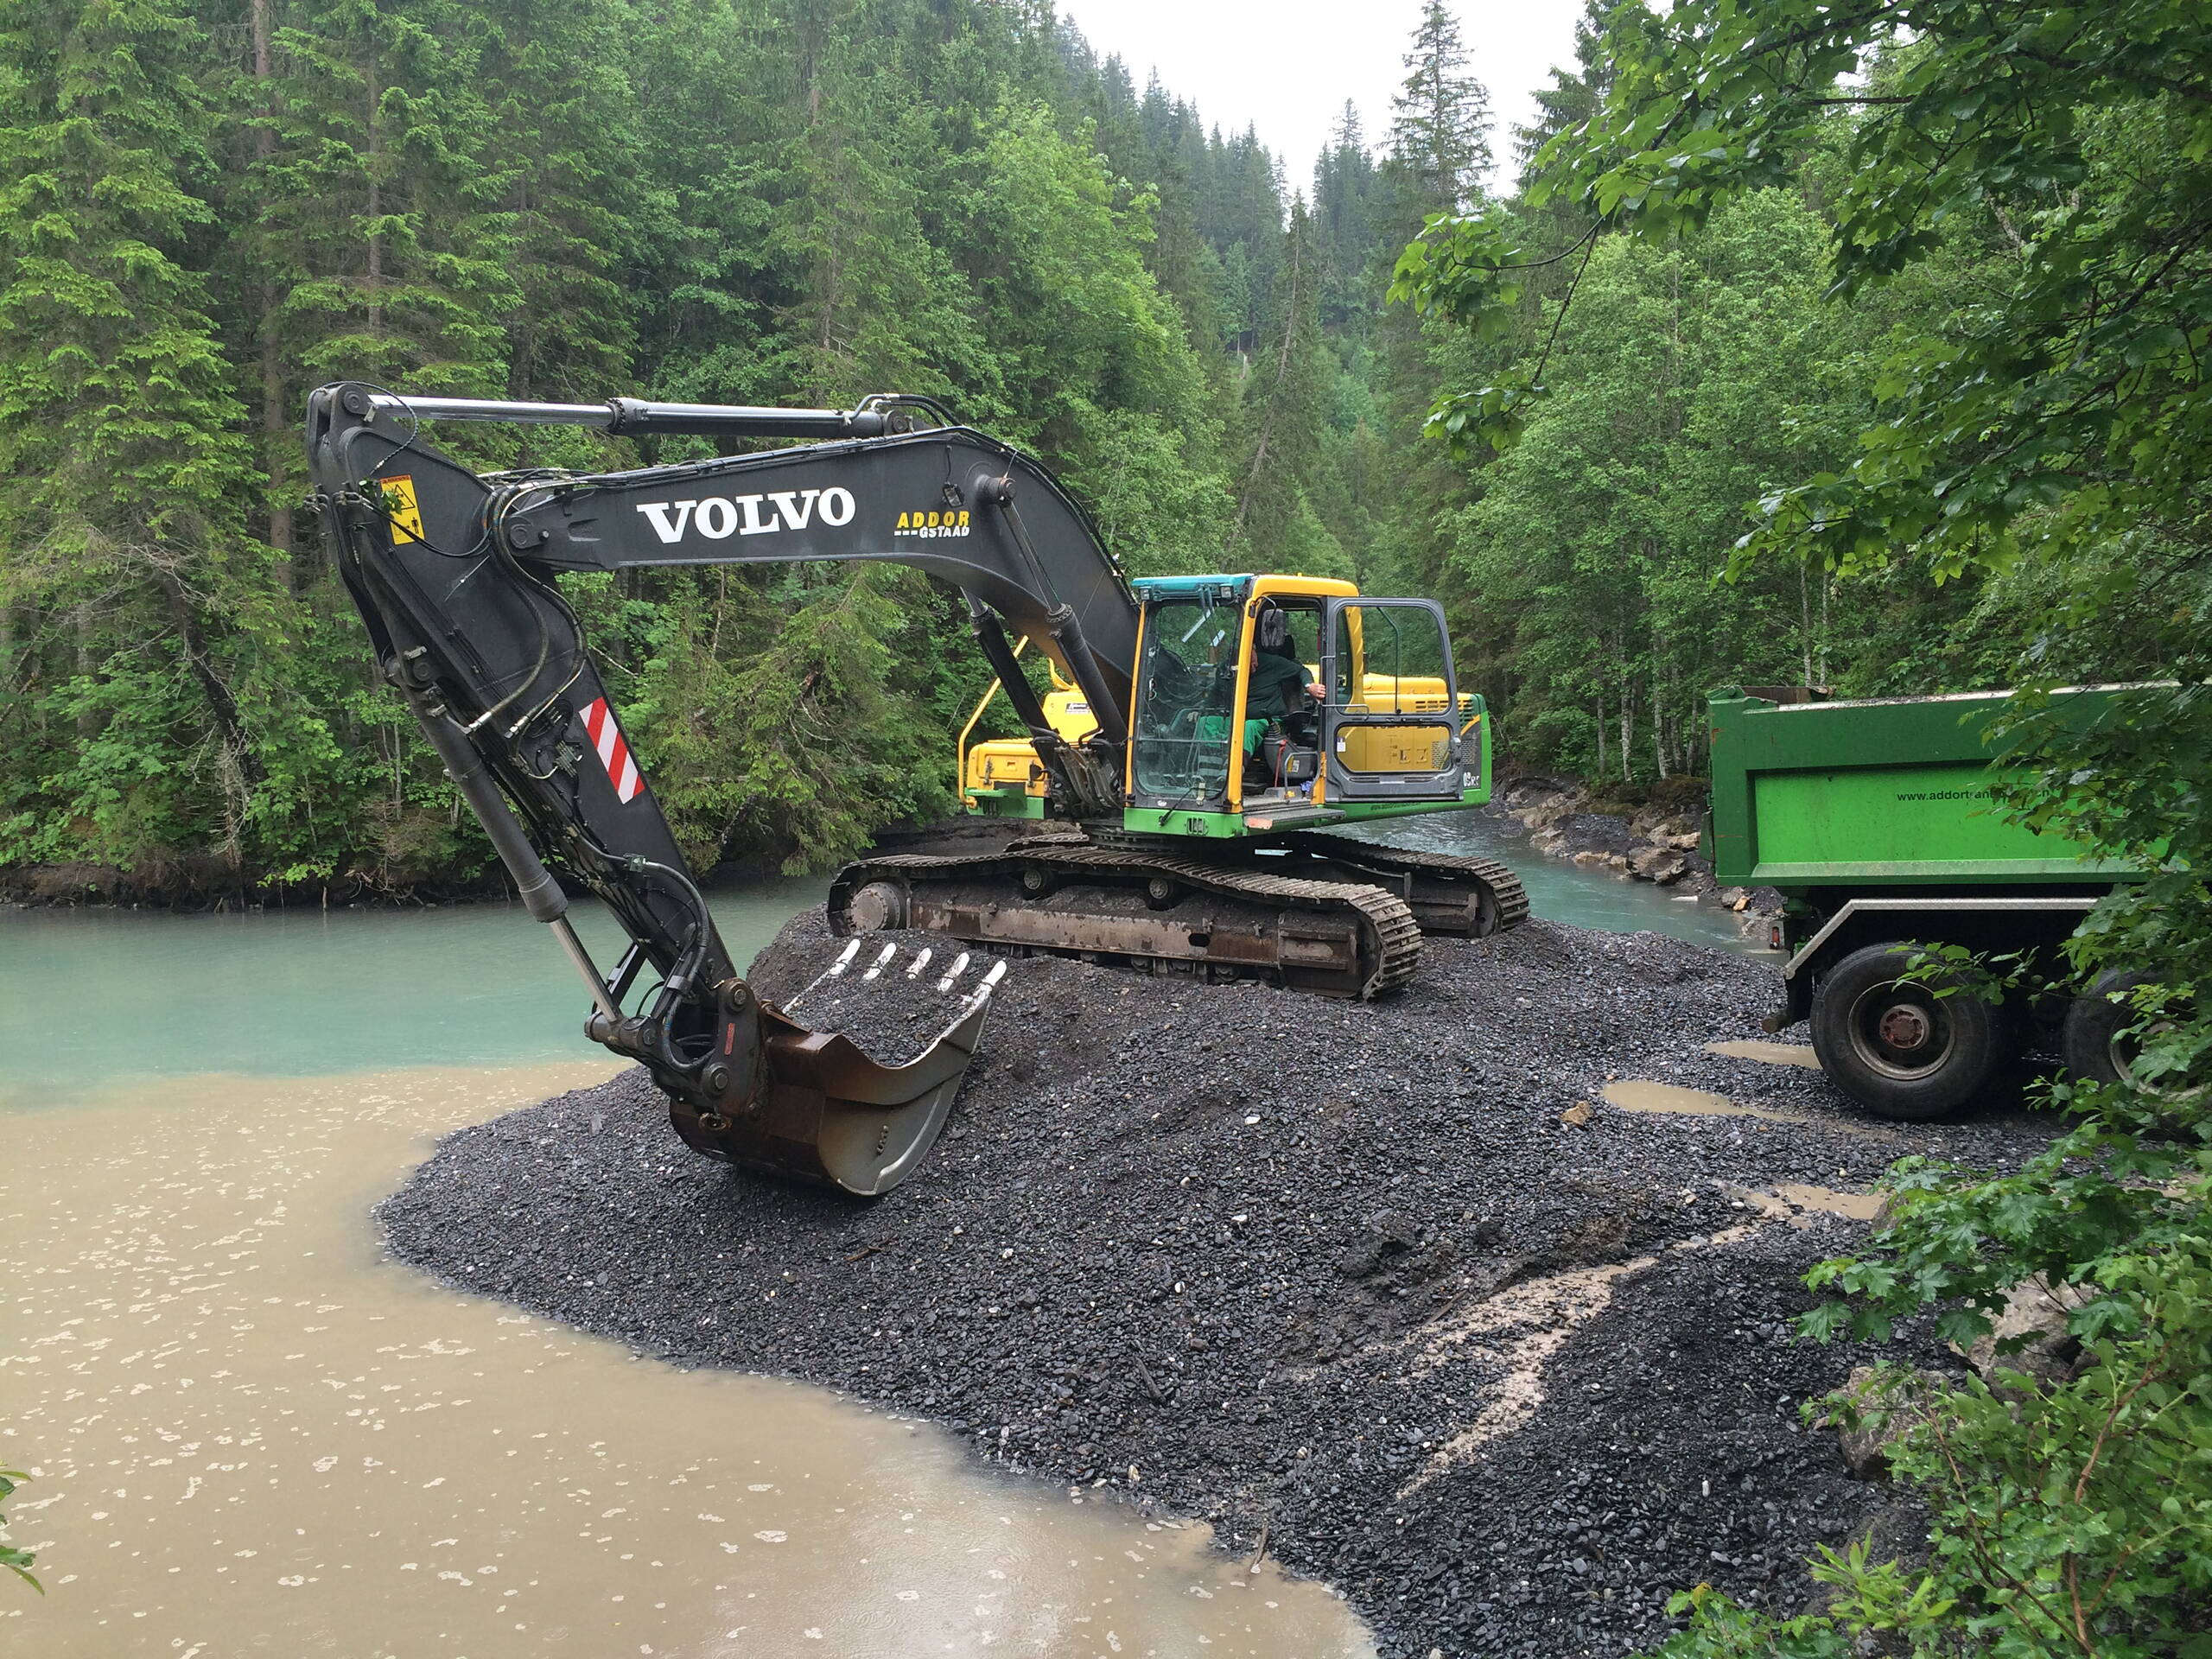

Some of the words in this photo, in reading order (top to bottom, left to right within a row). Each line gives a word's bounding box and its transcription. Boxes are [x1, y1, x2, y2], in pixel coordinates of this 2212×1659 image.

[636, 486, 856, 543] VOLVO
[897, 511, 969, 528] ADDOR
[918, 524, 970, 538] GSTAAD
